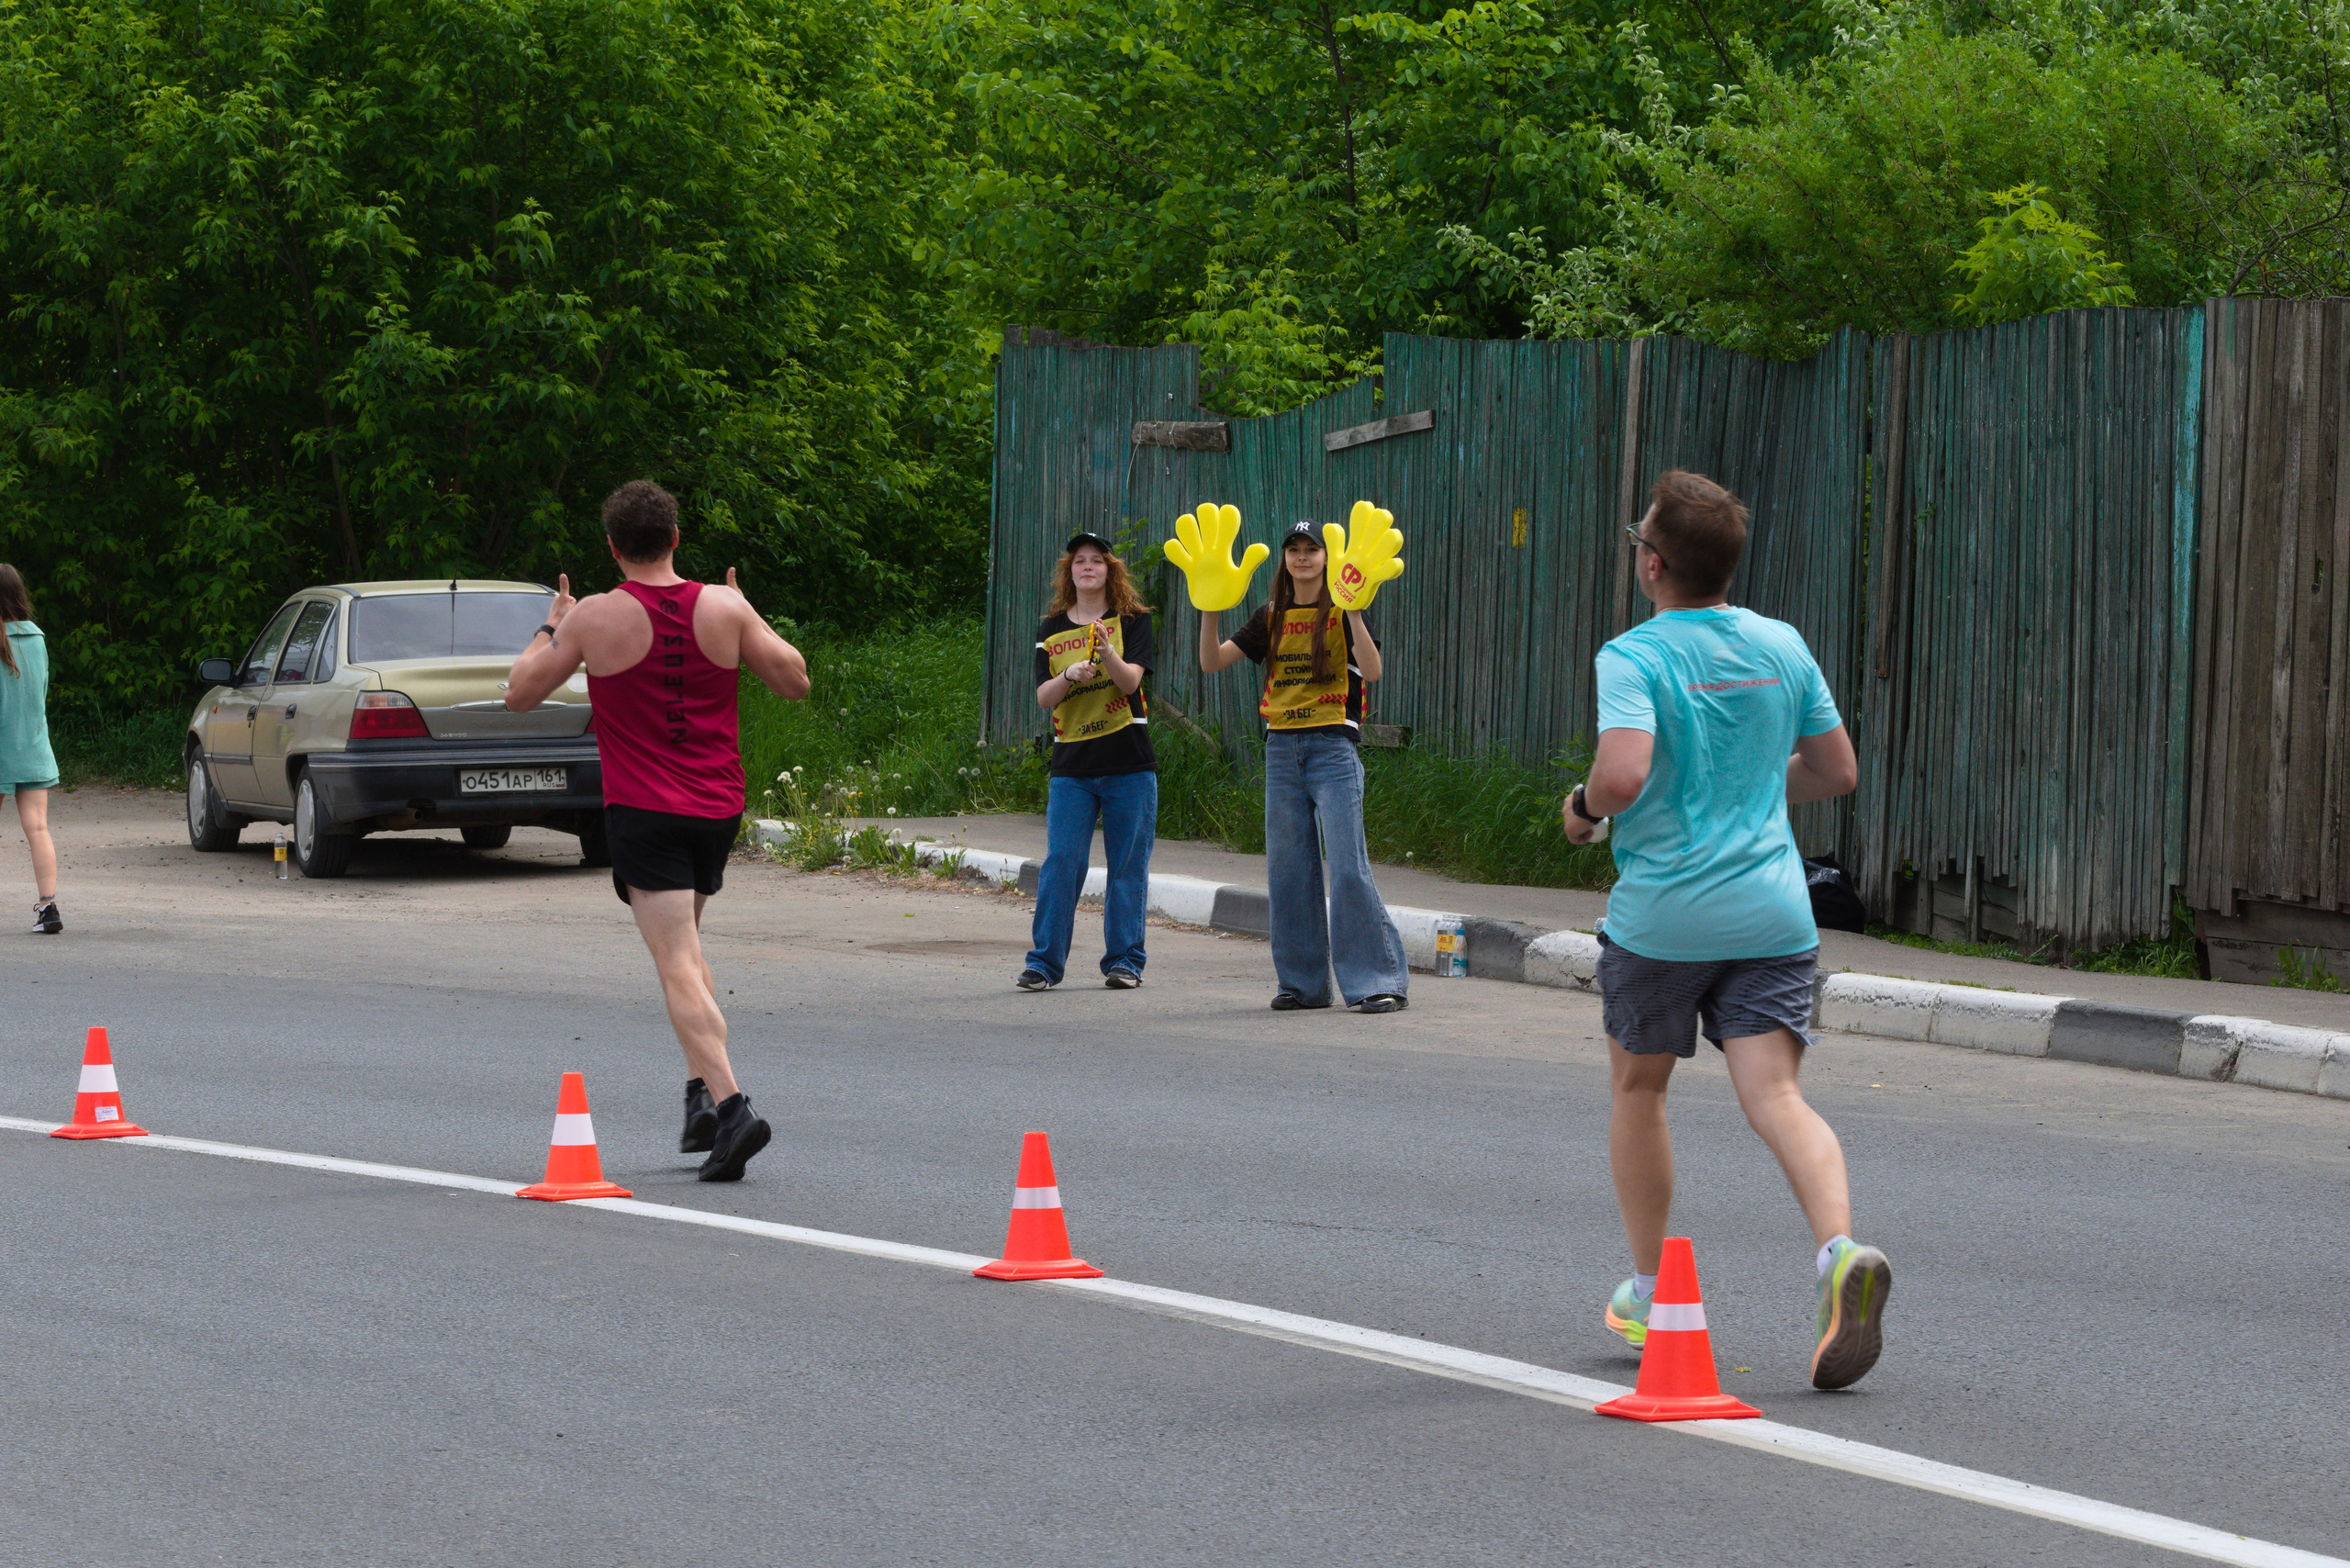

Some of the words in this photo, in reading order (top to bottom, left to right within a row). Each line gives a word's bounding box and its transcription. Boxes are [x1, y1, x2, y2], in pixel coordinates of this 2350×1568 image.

[1275, 649, 1332, 663] МОБИЛЬЯ
[1272, 673, 1337, 689] ИНФОРМАИИ
[1061, 678, 1115, 704] НФОРМАЦИИ
[537, 768, 562, 783] 161
